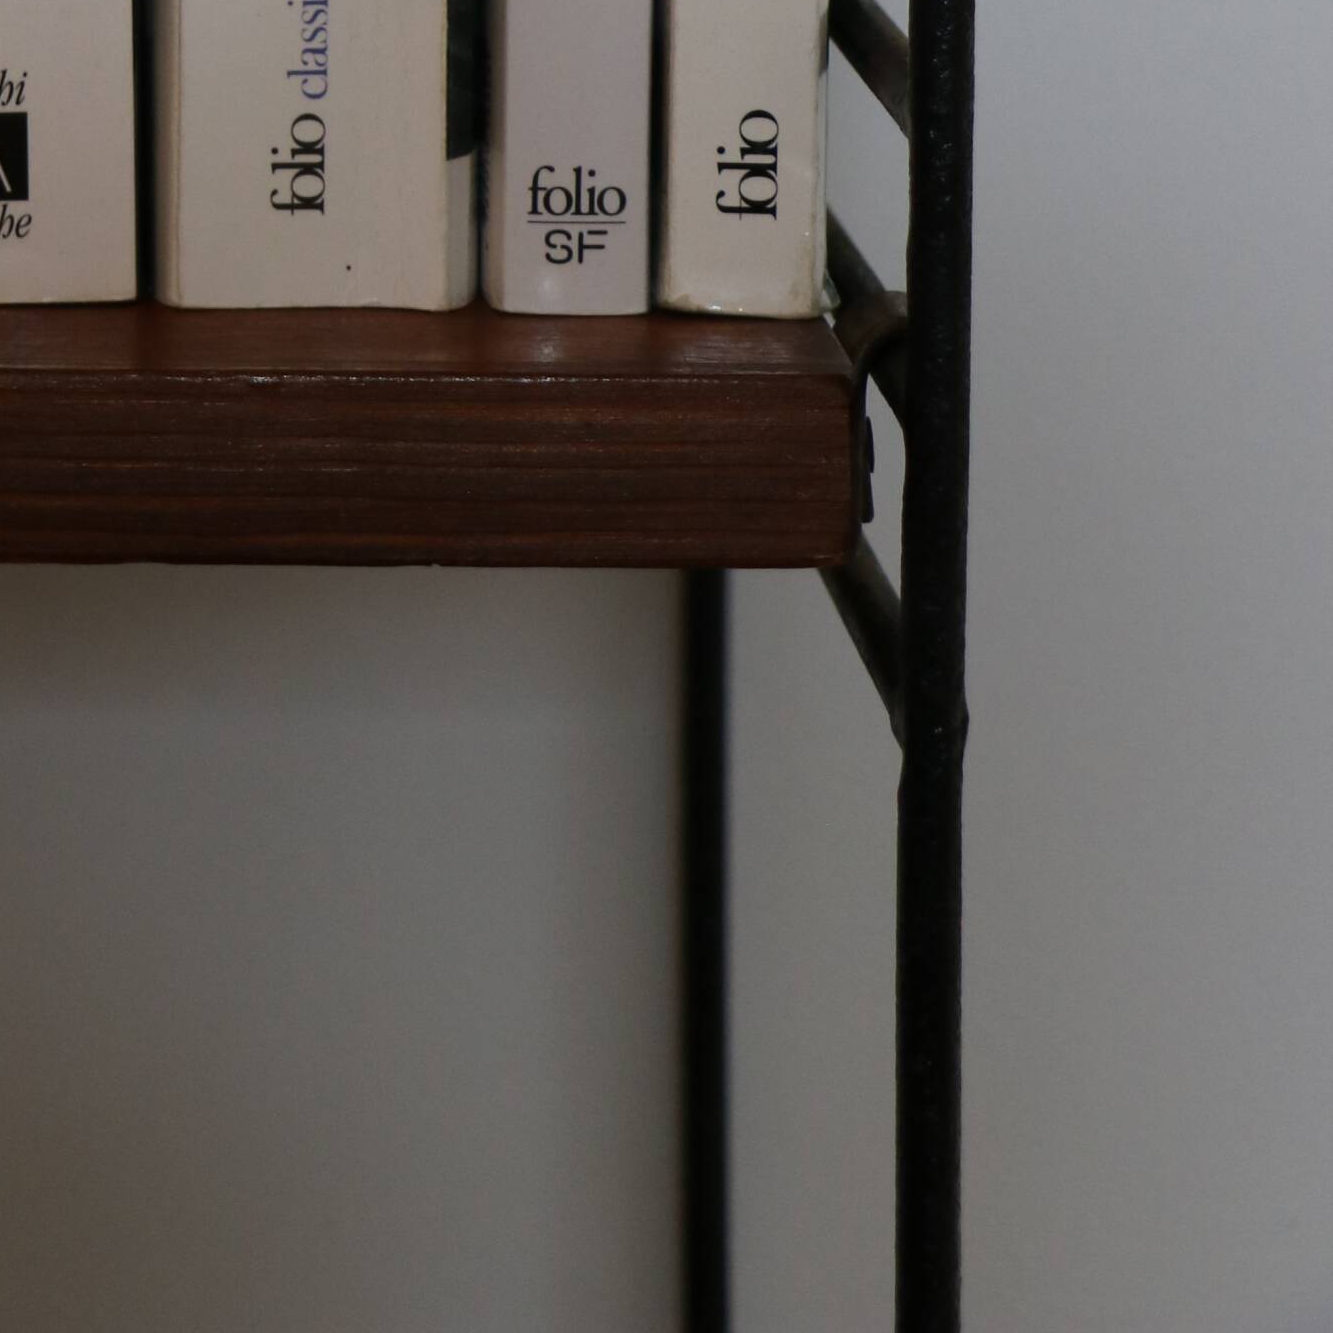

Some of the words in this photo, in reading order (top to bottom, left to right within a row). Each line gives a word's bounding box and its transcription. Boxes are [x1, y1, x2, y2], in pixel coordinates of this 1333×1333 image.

[269, 112, 327, 218] folio
[527, 165, 627, 216] folio
[715, 109, 781, 221] folio
[543, 228, 608, 265] SF
